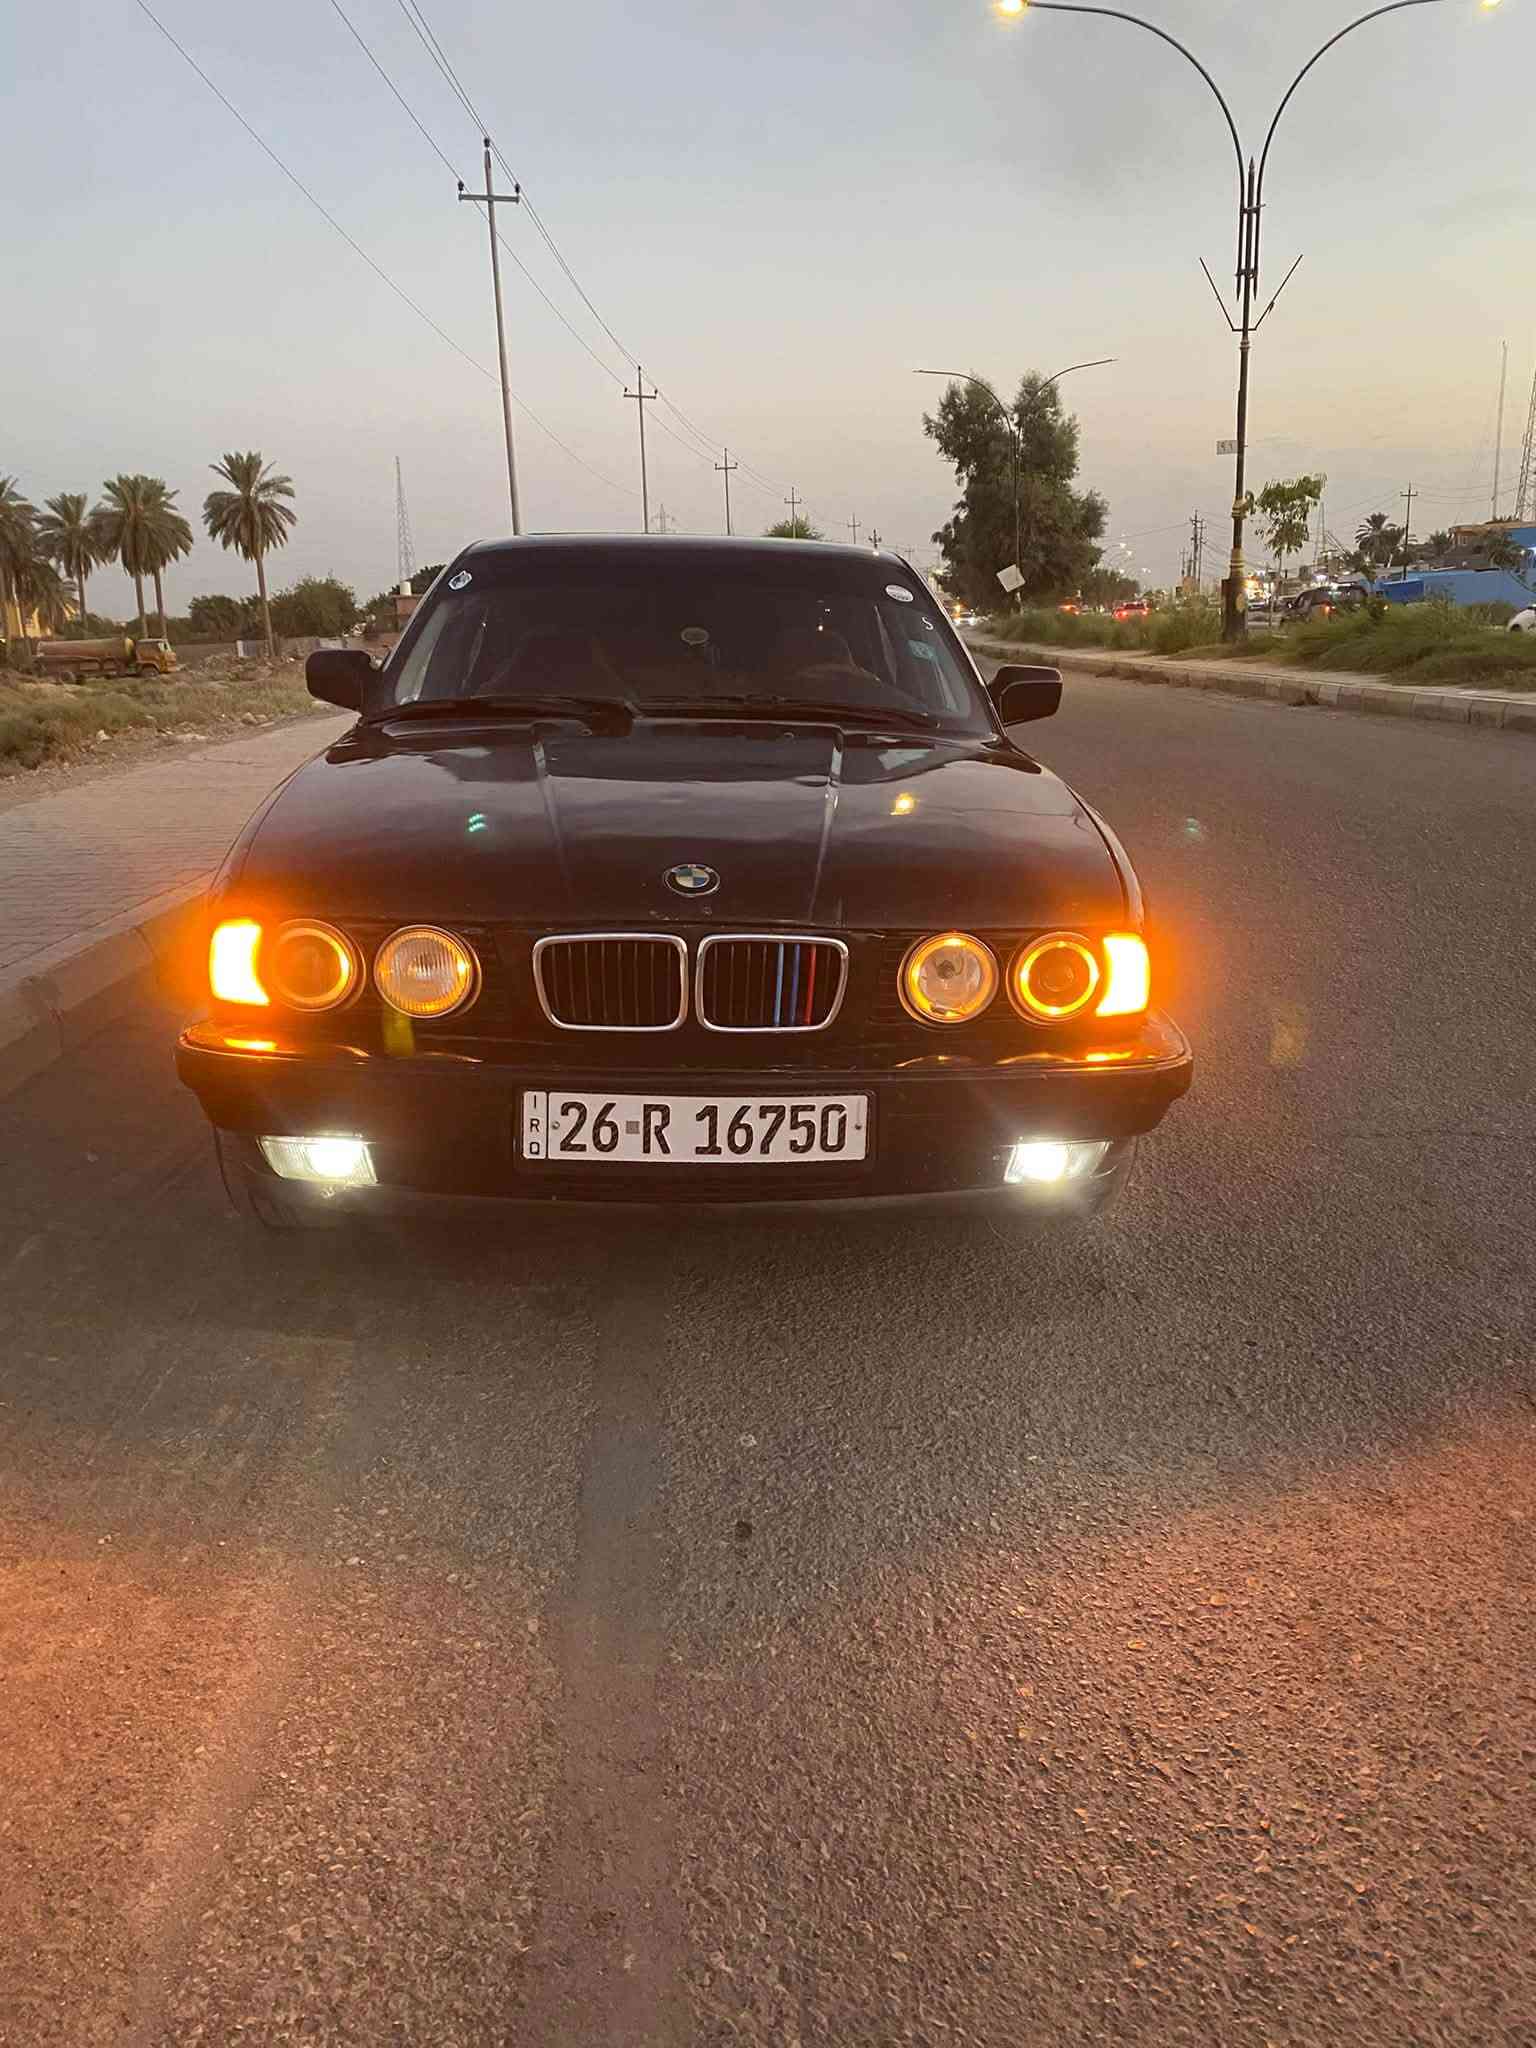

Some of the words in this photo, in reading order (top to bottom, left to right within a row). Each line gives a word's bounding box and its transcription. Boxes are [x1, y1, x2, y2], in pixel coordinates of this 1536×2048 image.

[529, 1094, 540, 1155] IRQ
[559, 1101, 619, 1153] 26
[642, 1103, 671, 1155] R
[694, 1103, 848, 1156] 16750
